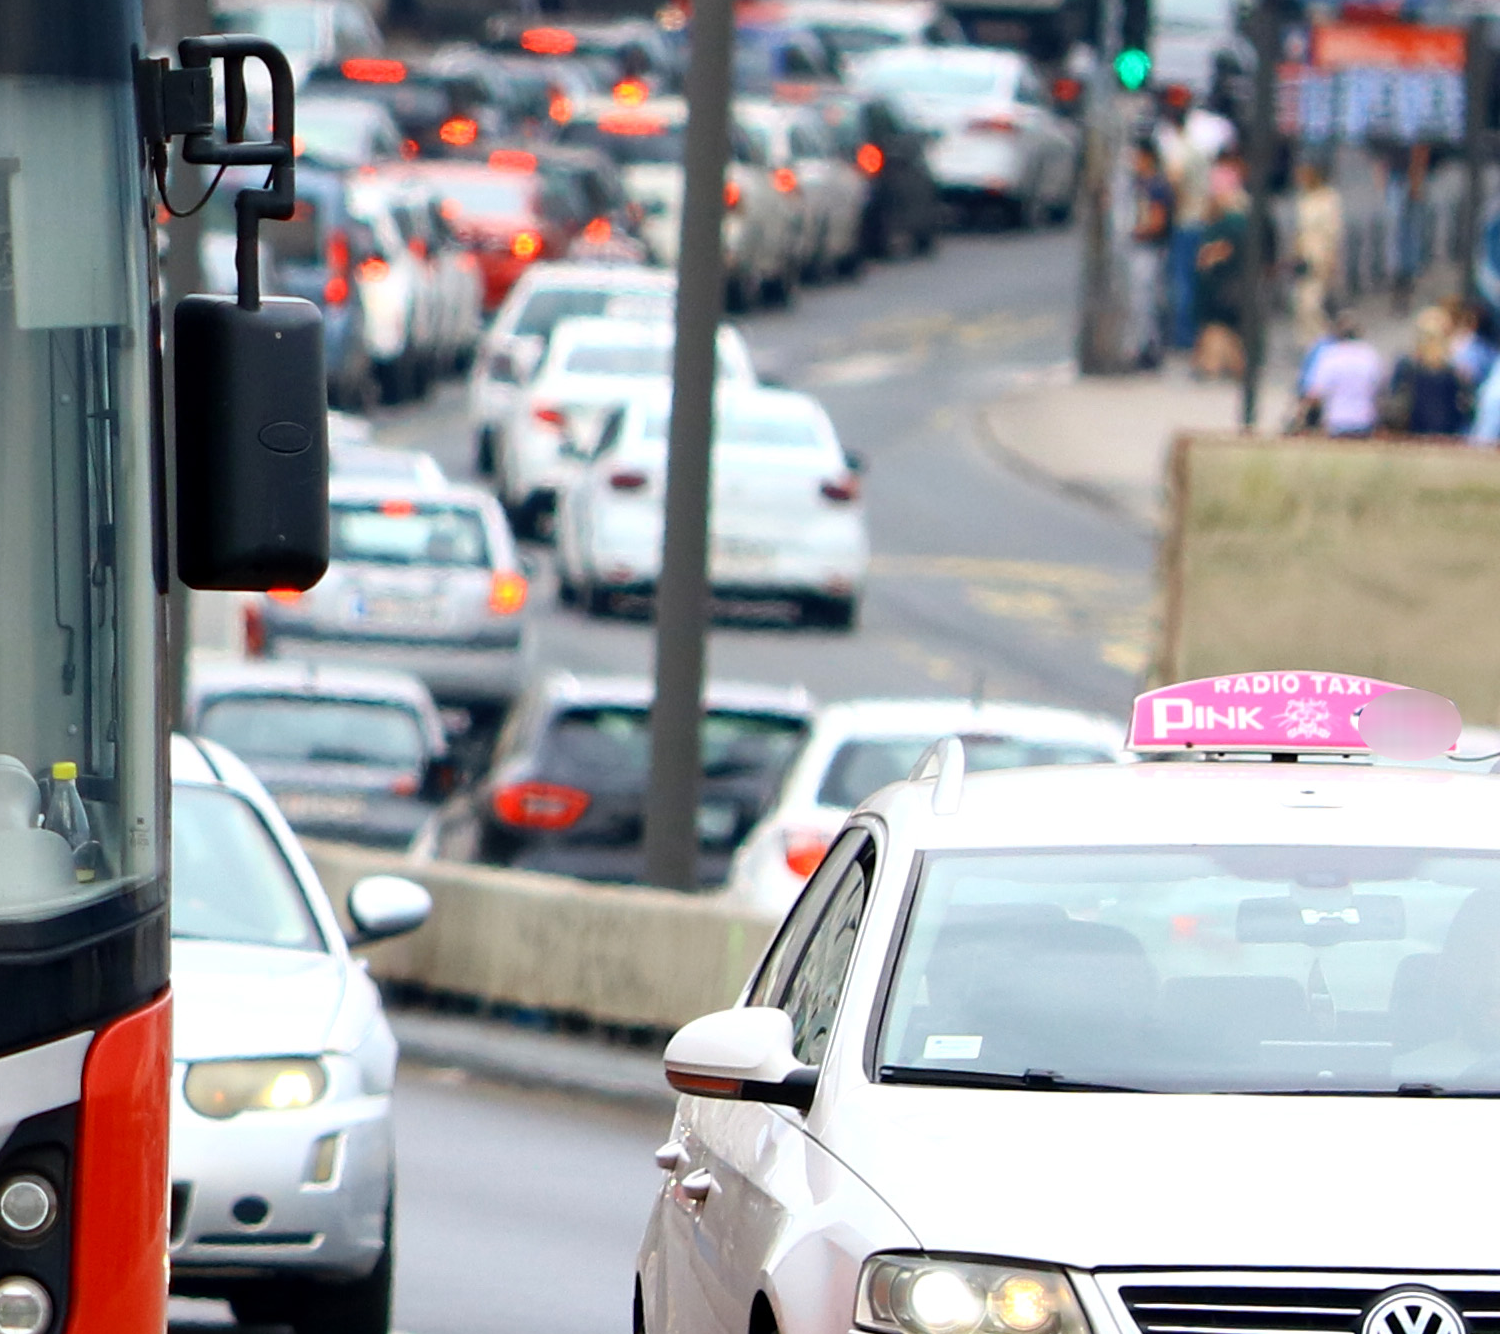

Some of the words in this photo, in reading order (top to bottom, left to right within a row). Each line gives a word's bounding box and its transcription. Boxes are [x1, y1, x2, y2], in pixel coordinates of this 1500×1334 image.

[1214, 674, 1301, 695] RADIO
[1310, 674, 1372, 695] TAXI
[1152, 698, 1264, 739] PINK
